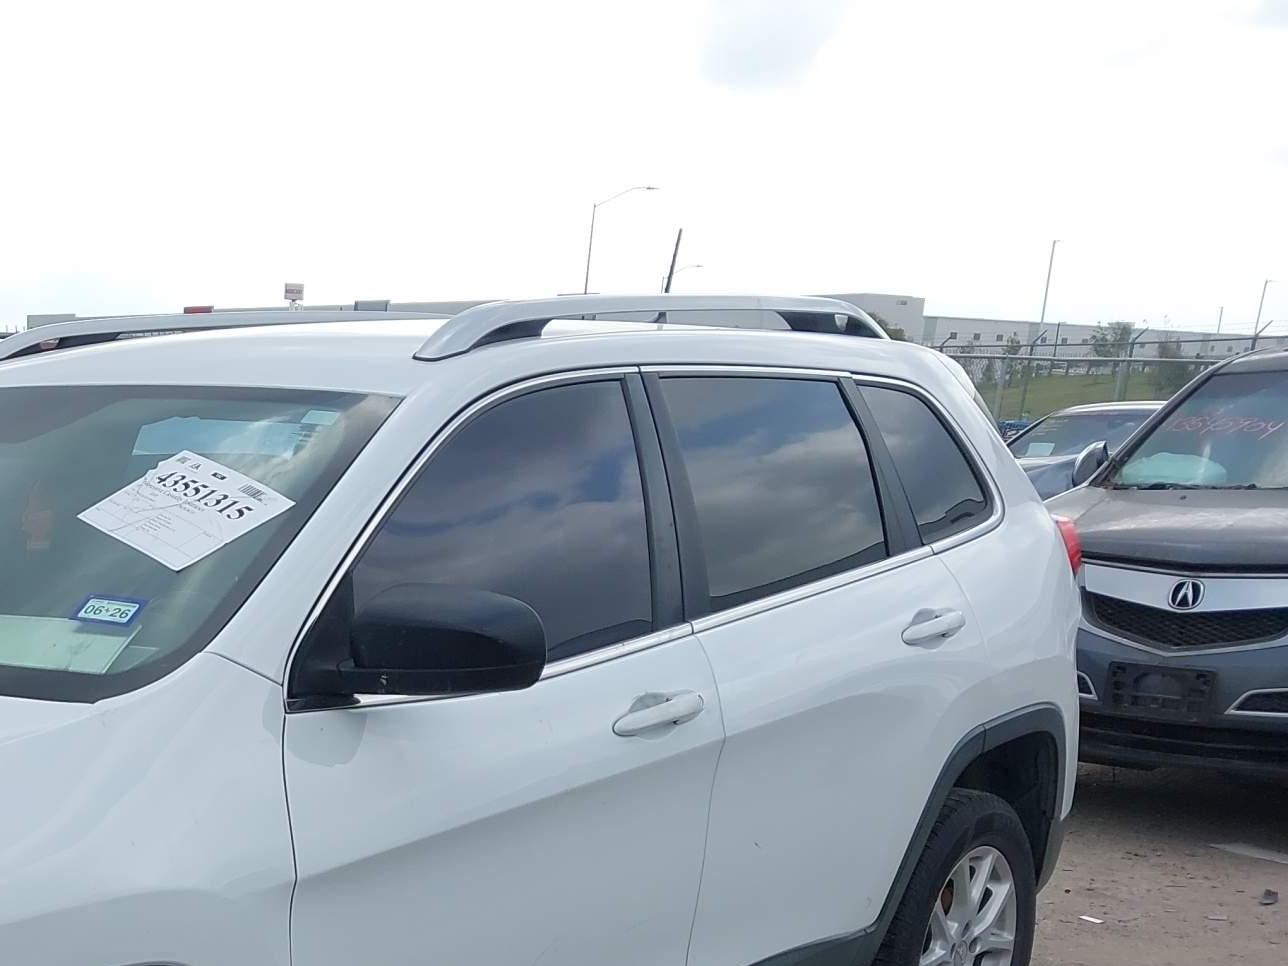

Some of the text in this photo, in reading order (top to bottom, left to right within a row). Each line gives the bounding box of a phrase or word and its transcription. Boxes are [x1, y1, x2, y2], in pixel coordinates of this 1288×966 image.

[156, 472, 255, 520] 43551315
[83, 604, 131, 619] 06 26
